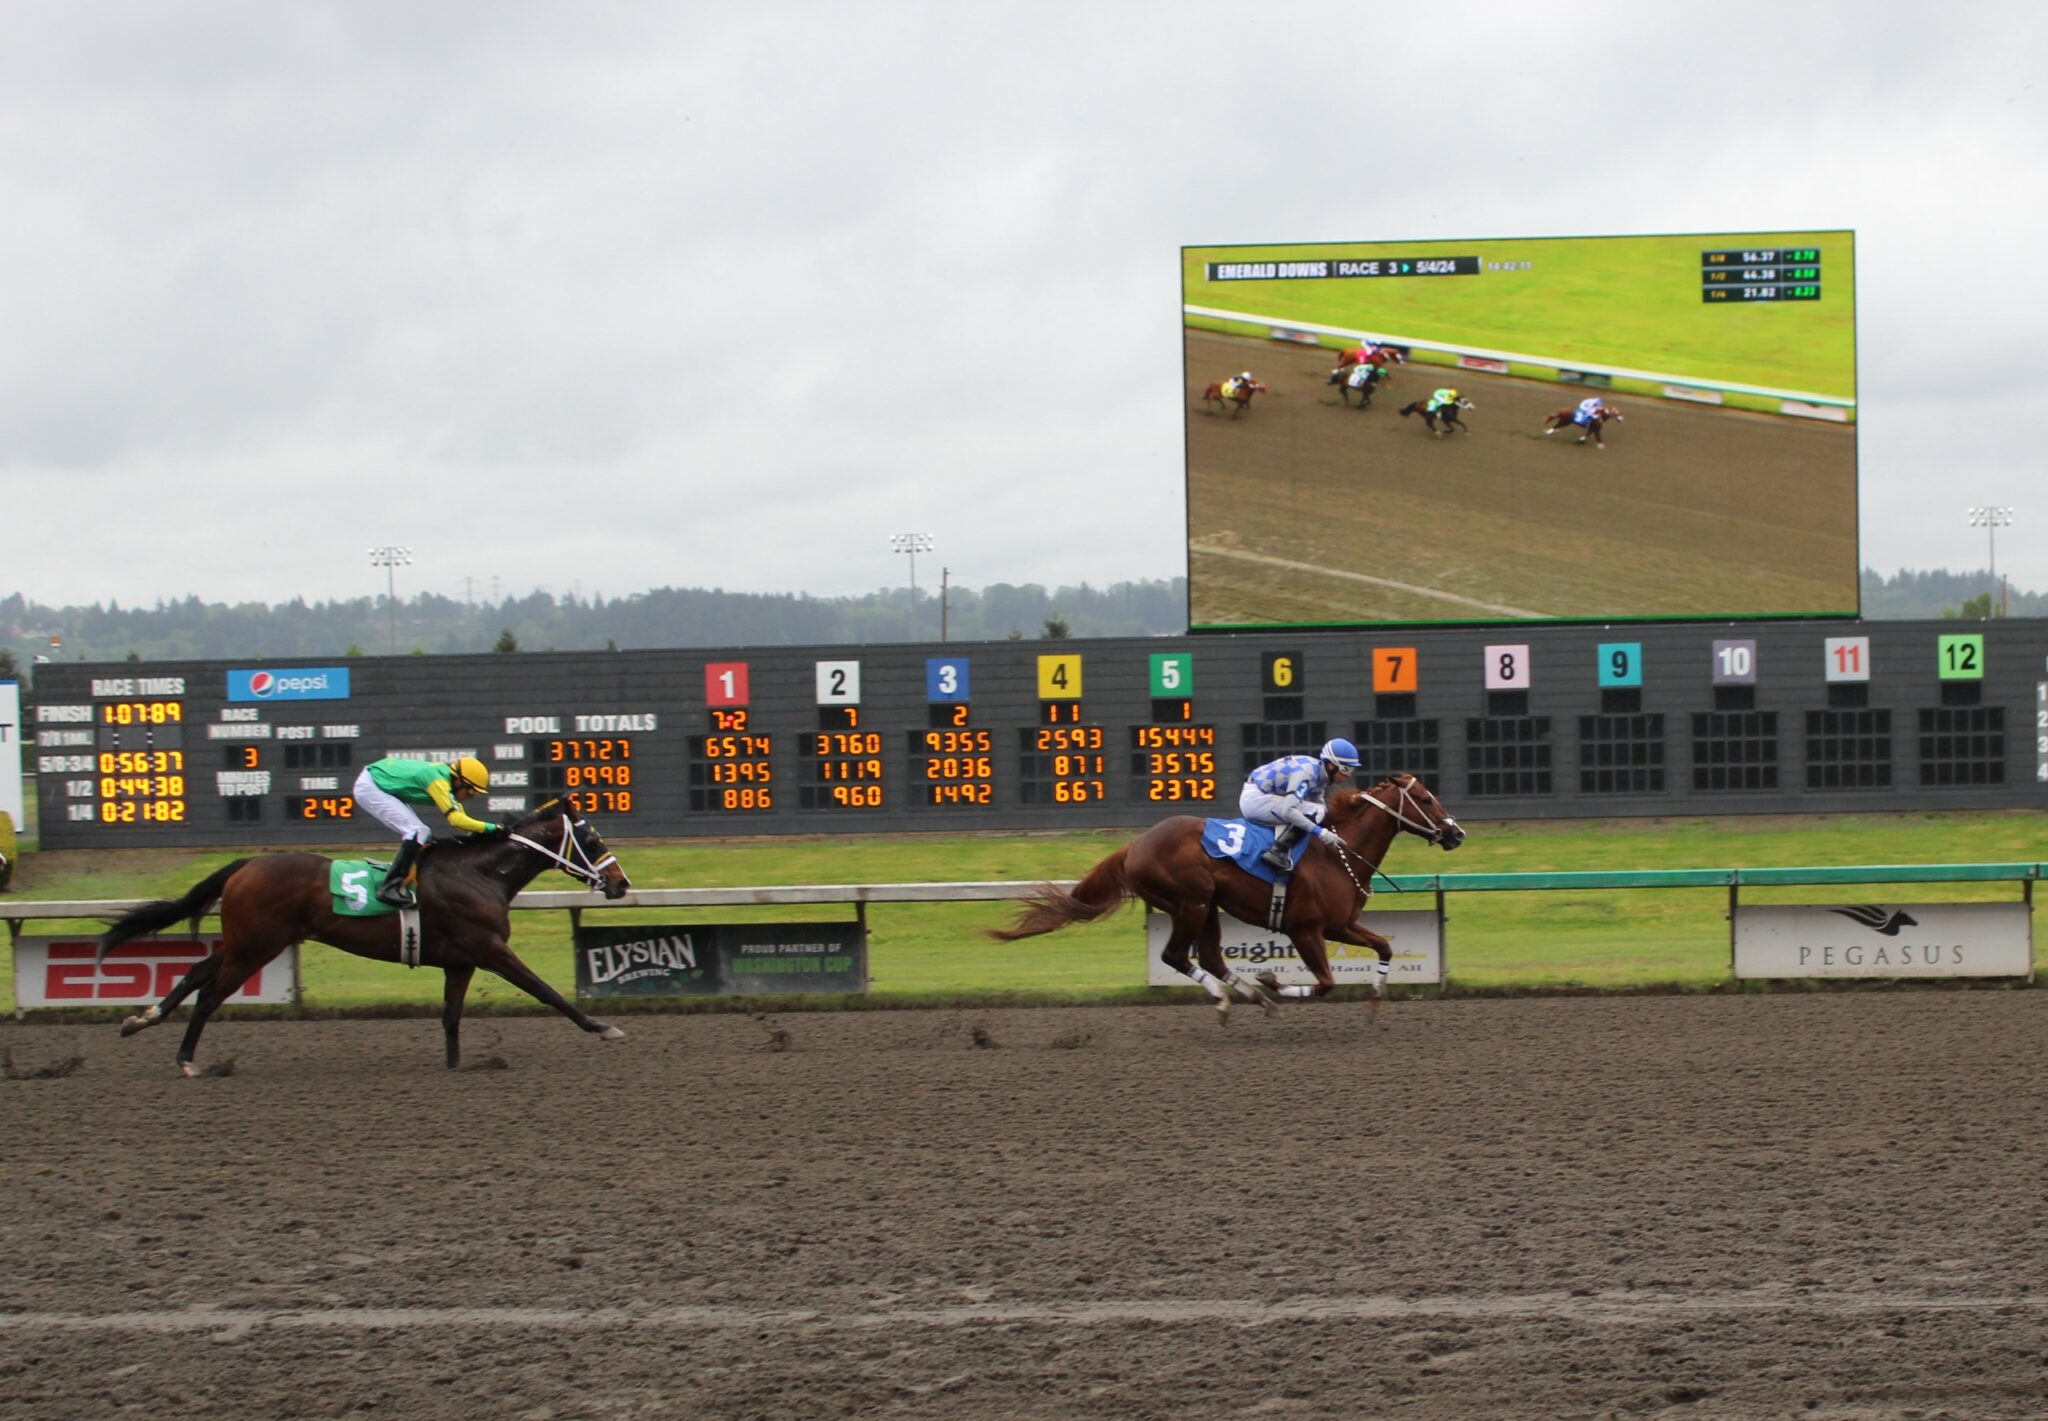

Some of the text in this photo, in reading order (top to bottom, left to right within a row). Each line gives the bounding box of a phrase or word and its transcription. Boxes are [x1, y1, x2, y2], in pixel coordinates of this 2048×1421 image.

[1743, 251, 1775, 262] 56.37
[1217, 260, 1456, 279] EMERALD DOWNS RACE 3 5/4/24
[1500, 653, 1515, 680] 8
[1612, 651, 1628, 678] 9
[1719, 647, 1750, 676] 10
[1834, 645, 1861, 673] 11
[1946, 643, 1976, 670] 12
[938, 665, 958, 694] 3
[1052, 664, 1068, 689] 4
[1162, 660, 1181, 689] 5
[1273, 657, 1292, 687] 6
[1387, 656, 1403, 683] 7
[92, 678, 185, 696] RACE TIMES
[277, 675, 329, 693] pepsi
[719, 671, 734, 698] 1
[831, 669, 846, 695] 2
[37, 705, 93, 722] FINISH
[221, 709, 258, 721] RACE
[844, 708, 857, 727] 7
[953, 706, 968, 726] 2
[1050, 704, 1079, 722] 11
[1183, 702, 1191, 720] 1
[208, 724, 270, 739] NUMBER
[277, 725, 360, 739] POST TIME
[506, 714, 657, 734] POOL TOTALS
[706, 736, 770, 758] 6574
[817, 733, 881, 755] 3760
[926, 732, 991, 753] 9355
[1038, 729, 1102, 750] 2593
[1138, 727, 1214, 748] 15444
[244, 748, 259, 768] 3
[494, 744, 524, 760] WIN
[551, 740, 630, 761] 37727
[713, 762, 770, 783] 1395
[824, 760, 881, 780] 1119
[927, 757, 991, 779] 2036
[1055, 755, 1104, 776] 871
[1151, 753, 1214, 774] 3575
[216, 771, 271, 784] MINUTES
[301, 777, 338, 790] TIME
[488, 771, 528, 786] PLACE
[566, 765, 631, 787] 8998
[66, 780, 93, 797] 1/2
[218, 783, 270, 796] TO POST
[724, 788, 771, 809] 886
[834, 785, 881, 806] 960
[935, 783, 992, 804] 1492
[1055, 781, 1104, 802] 667
[1150, 779, 1215, 801] 2372
[67, 804, 94, 821] 1/4
[488, 798, 525, 811] SHOW
[1216, 823, 1246, 856] 3
[341, 869, 369, 912] 5
[587, 933, 697, 984] ELYSIAN
[741, 943, 842, 954] PROUD PARTNER OF
[1799, 945, 1964, 966] PEGASUS
[45, 940, 263, 999] ESP
[825, 956, 852, 973] CUP
[1331, 965, 1372, 973] Haul
[1398, 964, 1423, 973] All
[617, 968, 671, 984] BREWING
